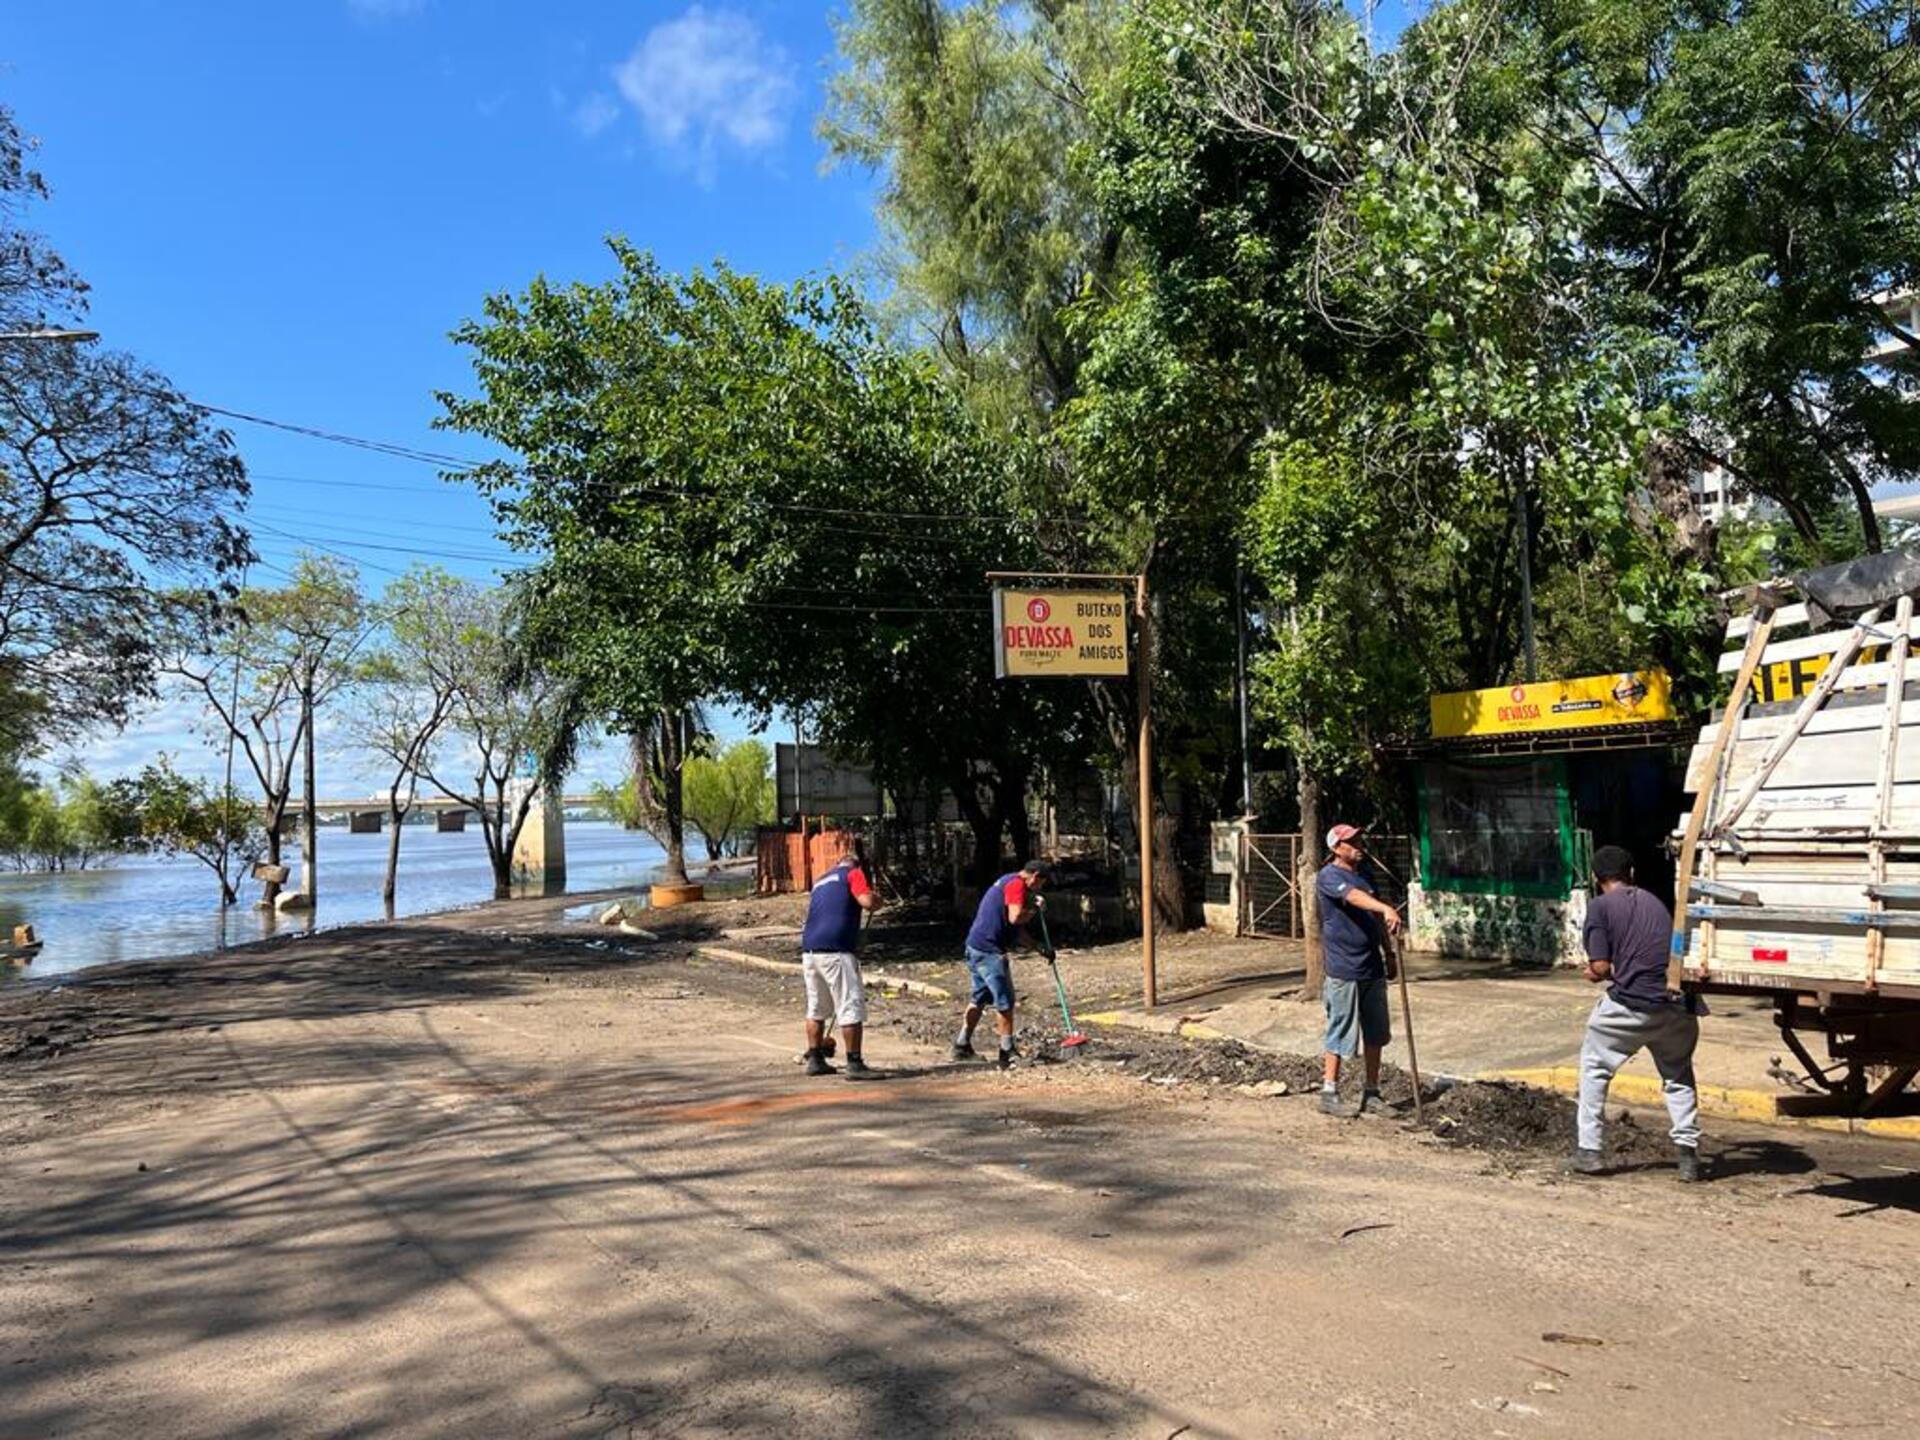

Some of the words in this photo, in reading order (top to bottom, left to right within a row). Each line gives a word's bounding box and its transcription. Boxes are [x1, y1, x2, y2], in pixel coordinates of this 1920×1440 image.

[1077, 603, 1122, 618] BUTEKO
[1006, 625, 1073, 649] DEVASSA
[1088, 624, 1112, 639] DOS
[1079, 645, 1124, 660] AMIGOS
[1498, 704, 1541, 722] DEVASSA
